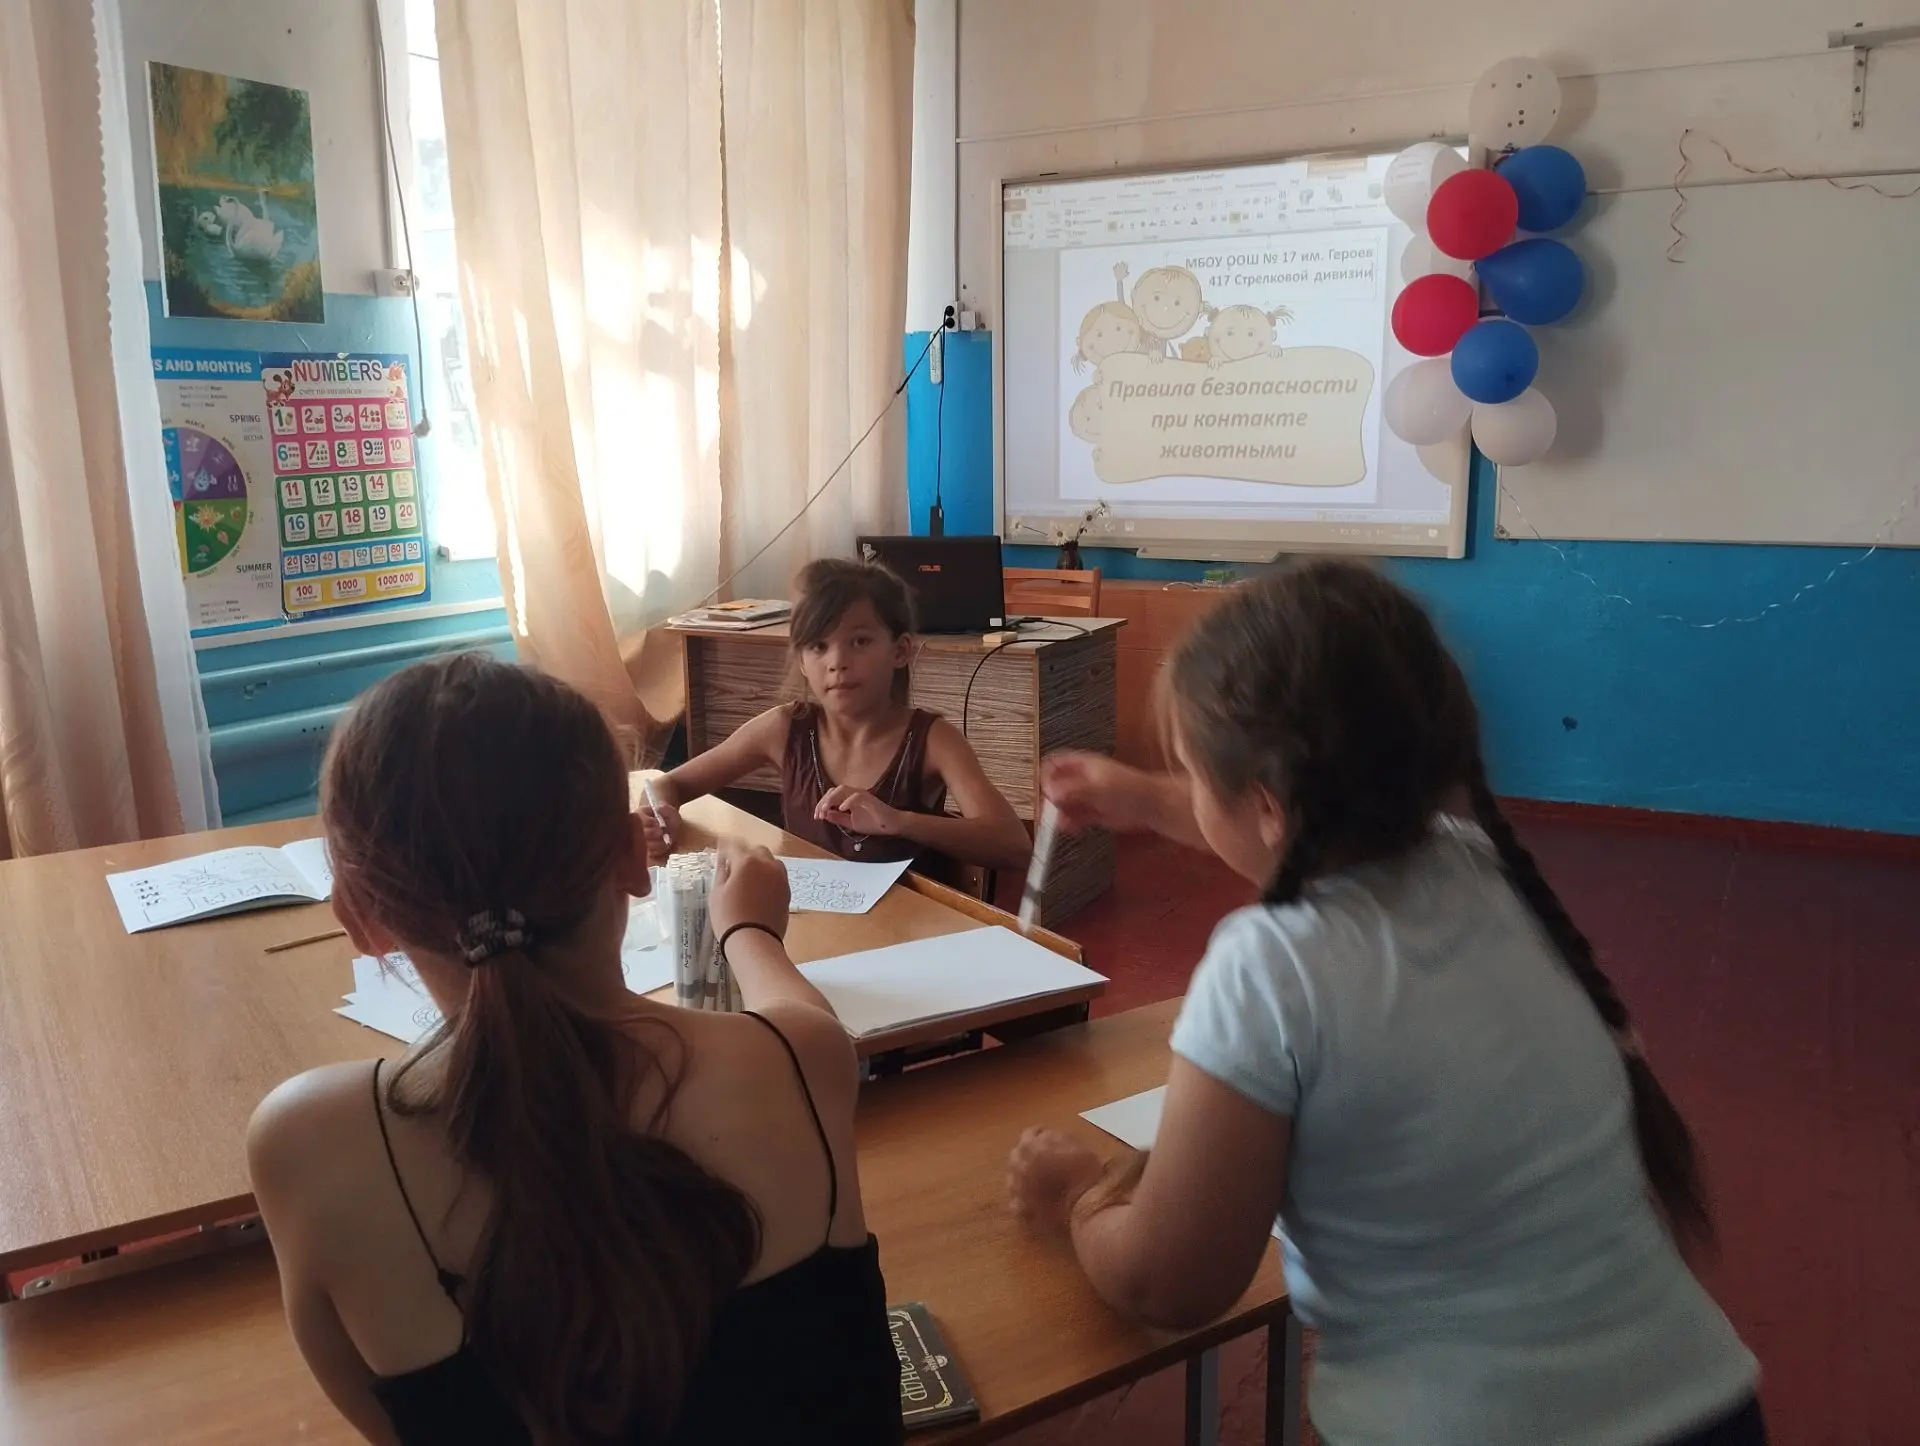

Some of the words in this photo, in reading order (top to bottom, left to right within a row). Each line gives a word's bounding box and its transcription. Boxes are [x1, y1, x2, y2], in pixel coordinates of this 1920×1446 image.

[1185, 256, 1222, 269] МБОУ
[1227, 255, 1259, 268] ООШ
[1263, 253, 1278, 265] №
[1283, 251, 1296, 263] 17
[1301, 252, 1324, 262] им.
[1329, 248, 1373, 261] Героев
[1209, 275, 1230, 287] 417
[1234, 270, 1308, 288] Стрелковой
[1313, 270, 1372, 283] дивизии
[166, 361, 193, 372] AND
[196, 361, 252, 373] MONTHS
[293, 360, 382, 381] NUMBERS
[1109, 380, 1195, 401] Правила
[1201, 377, 1359, 396] безопасности
[229, 414, 261, 423] SPRING
[274, 409, 284, 427] 1
[304, 408, 313, 423] 2
[333, 407, 343, 422] 3
[360, 407, 369, 422] 4
[1151, 413, 1187, 432] при
[1194, 411, 1308, 428] контакте
[307, 442, 318, 459] 7
[337, 442, 347, 458] 8
[363, 440, 373, 456] 9
[390, 440, 401, 451] 10
[1160, 443, 1297, 459] животными
[278, 445, 288, 461] 6
[285, 482, 299, 496] 11
[314, 480, 329, 494] 12
[342, 477, 358, 491] 13
[369, 476, 384, 490] 14
[345, 509, 360, 523] 18
[372, 507, 385, 520] 19
[400, 505, 413, 517] 20
[289, 515, 305, 530] 16
[318, 514, 333, 527] 17
[287, 557, 298, 566] 20
[304, 555, 316, 564] 30
[236, 563, 272, 573] SUMMER
[918, 564, 941, 572] ASUS
[297, 585, 313, 597] 100
[337, 579, 357, 590] 1000
